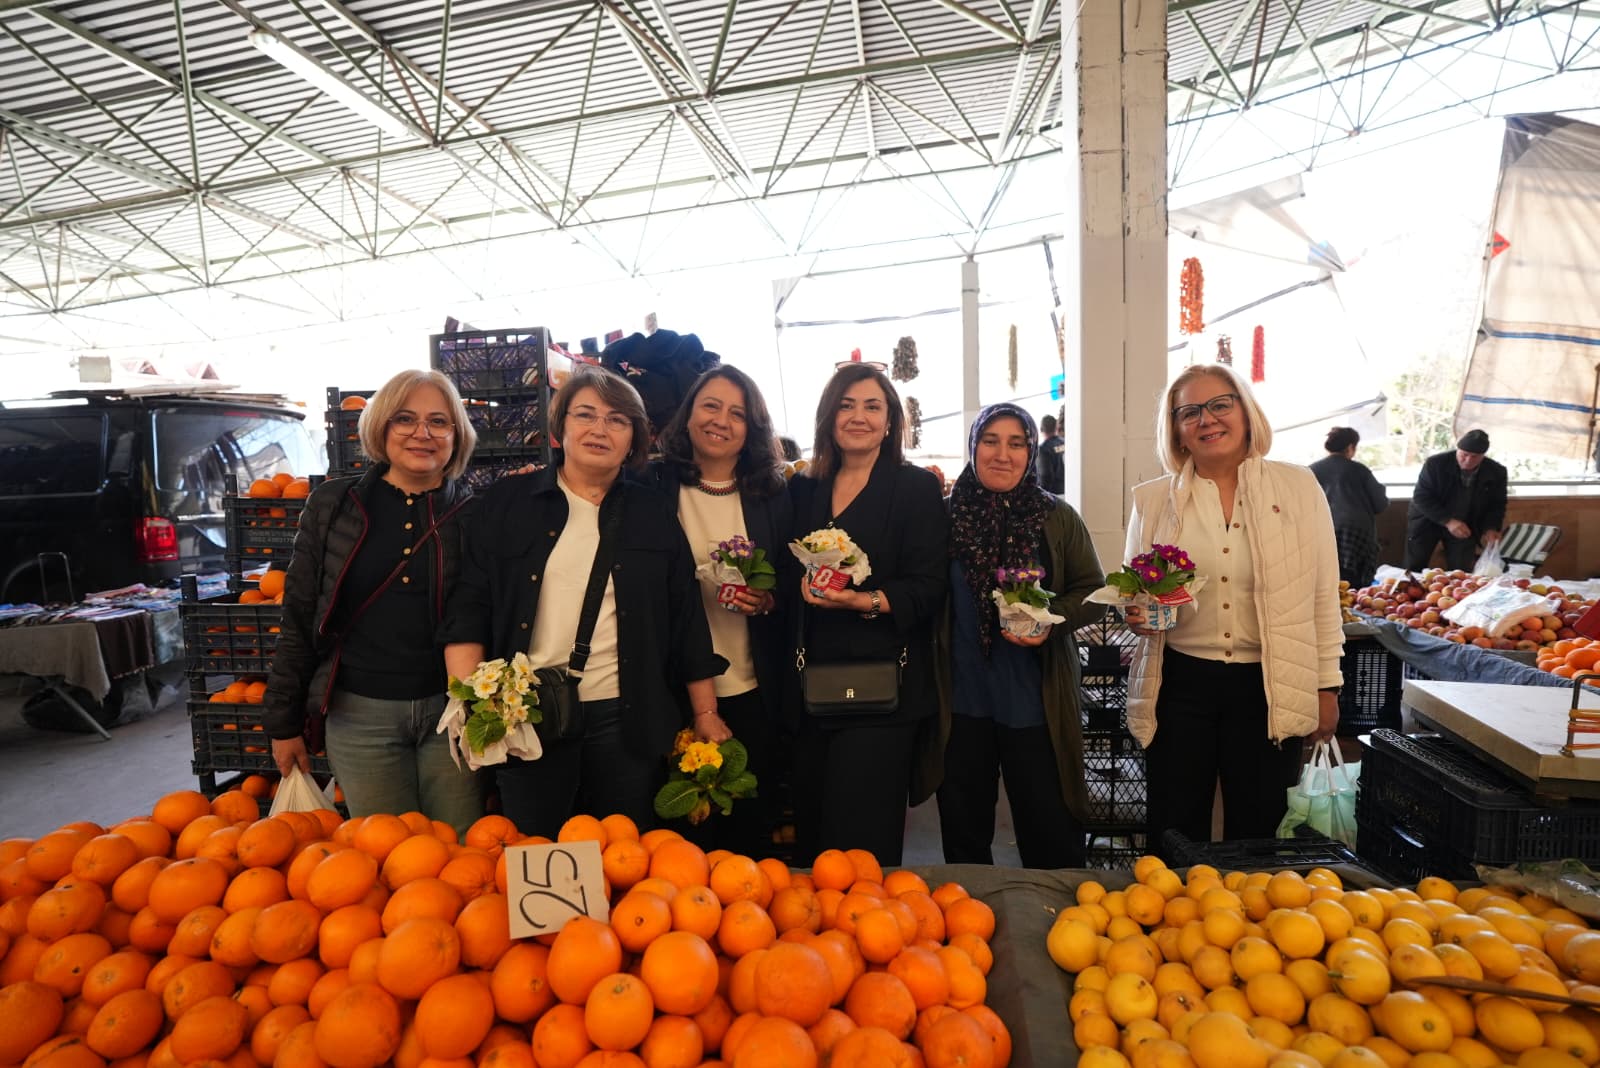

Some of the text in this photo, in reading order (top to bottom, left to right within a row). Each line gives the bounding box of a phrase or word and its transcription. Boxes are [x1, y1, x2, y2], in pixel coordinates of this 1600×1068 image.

[815, 568, 834, 587] 8
[721, 586, 737, 602] 8
[519, 849, 589, 930] 25
